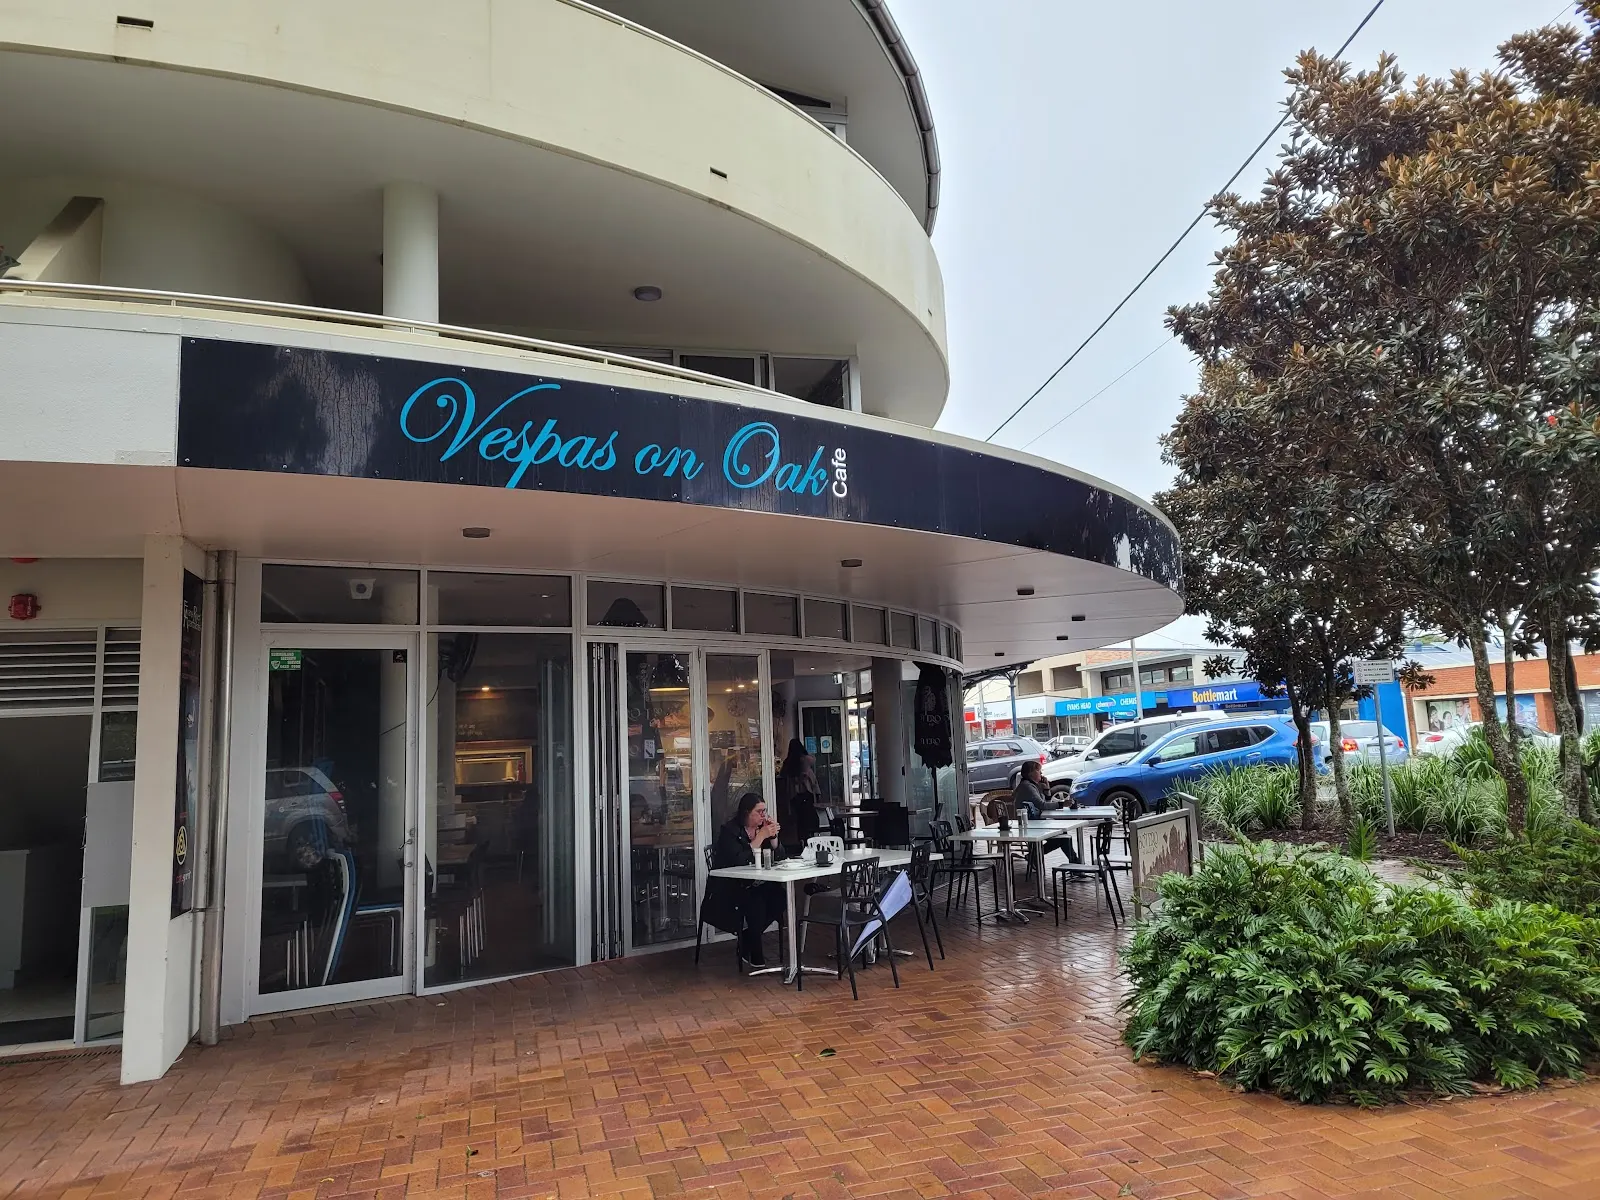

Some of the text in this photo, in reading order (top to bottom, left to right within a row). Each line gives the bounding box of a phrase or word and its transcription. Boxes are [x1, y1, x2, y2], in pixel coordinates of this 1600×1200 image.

[400, 377, 829, 496] Vespas on Oak
[831, 447, 848, 499] Cafe
[1119, 697, 1138, 706] CHEMIS
[1192, 688, 1238, 703] Bottlemart
[1066, 701, 1092, 711] EVANS HEAD
